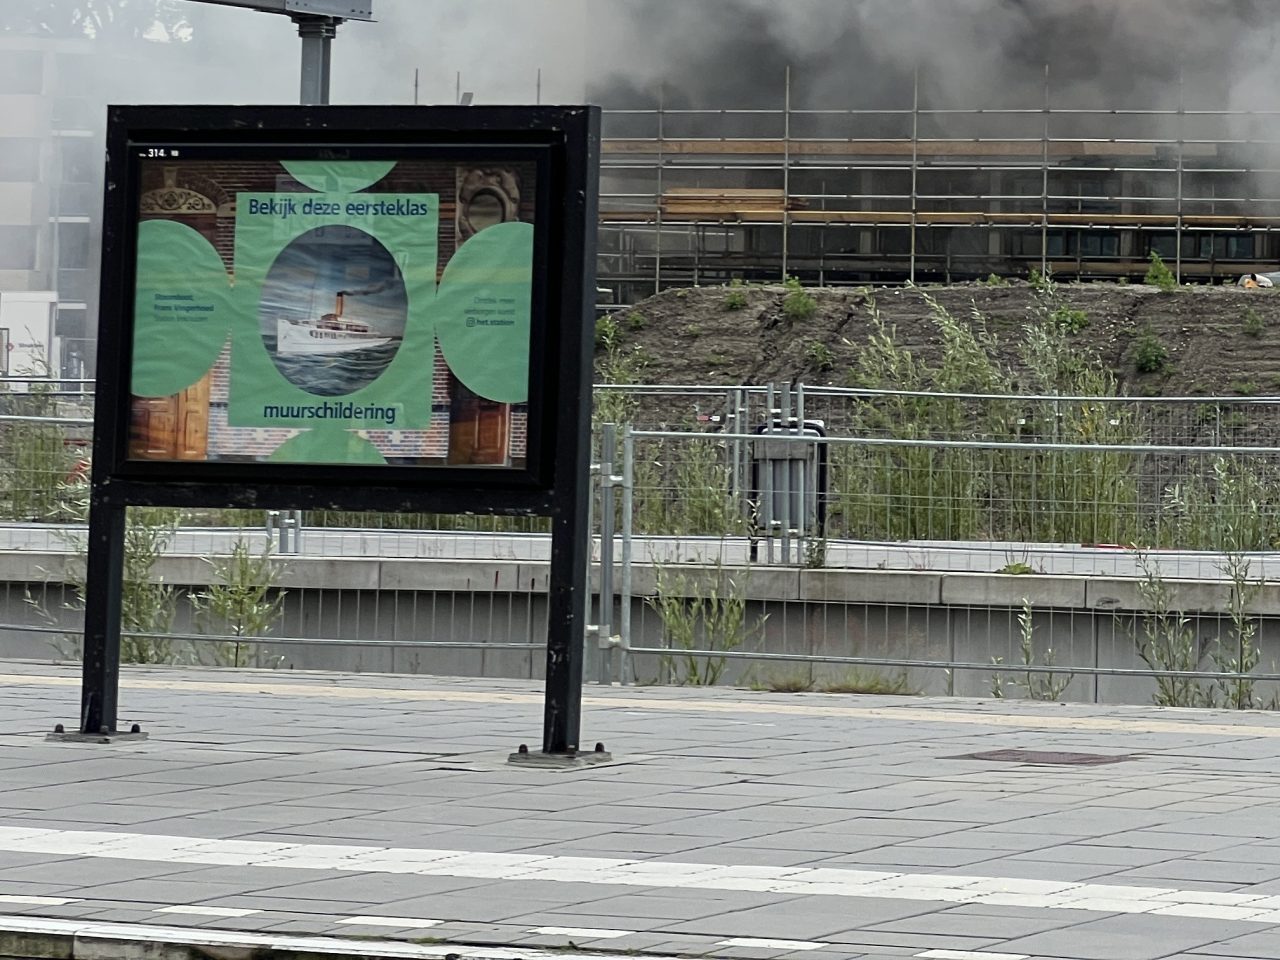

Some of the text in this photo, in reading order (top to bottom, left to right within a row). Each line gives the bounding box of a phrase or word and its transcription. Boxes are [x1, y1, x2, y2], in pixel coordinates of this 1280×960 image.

[249, 198, 428, 218] Bekijk deze eersteklas
[263, 401, 397, 425] muurschildering
